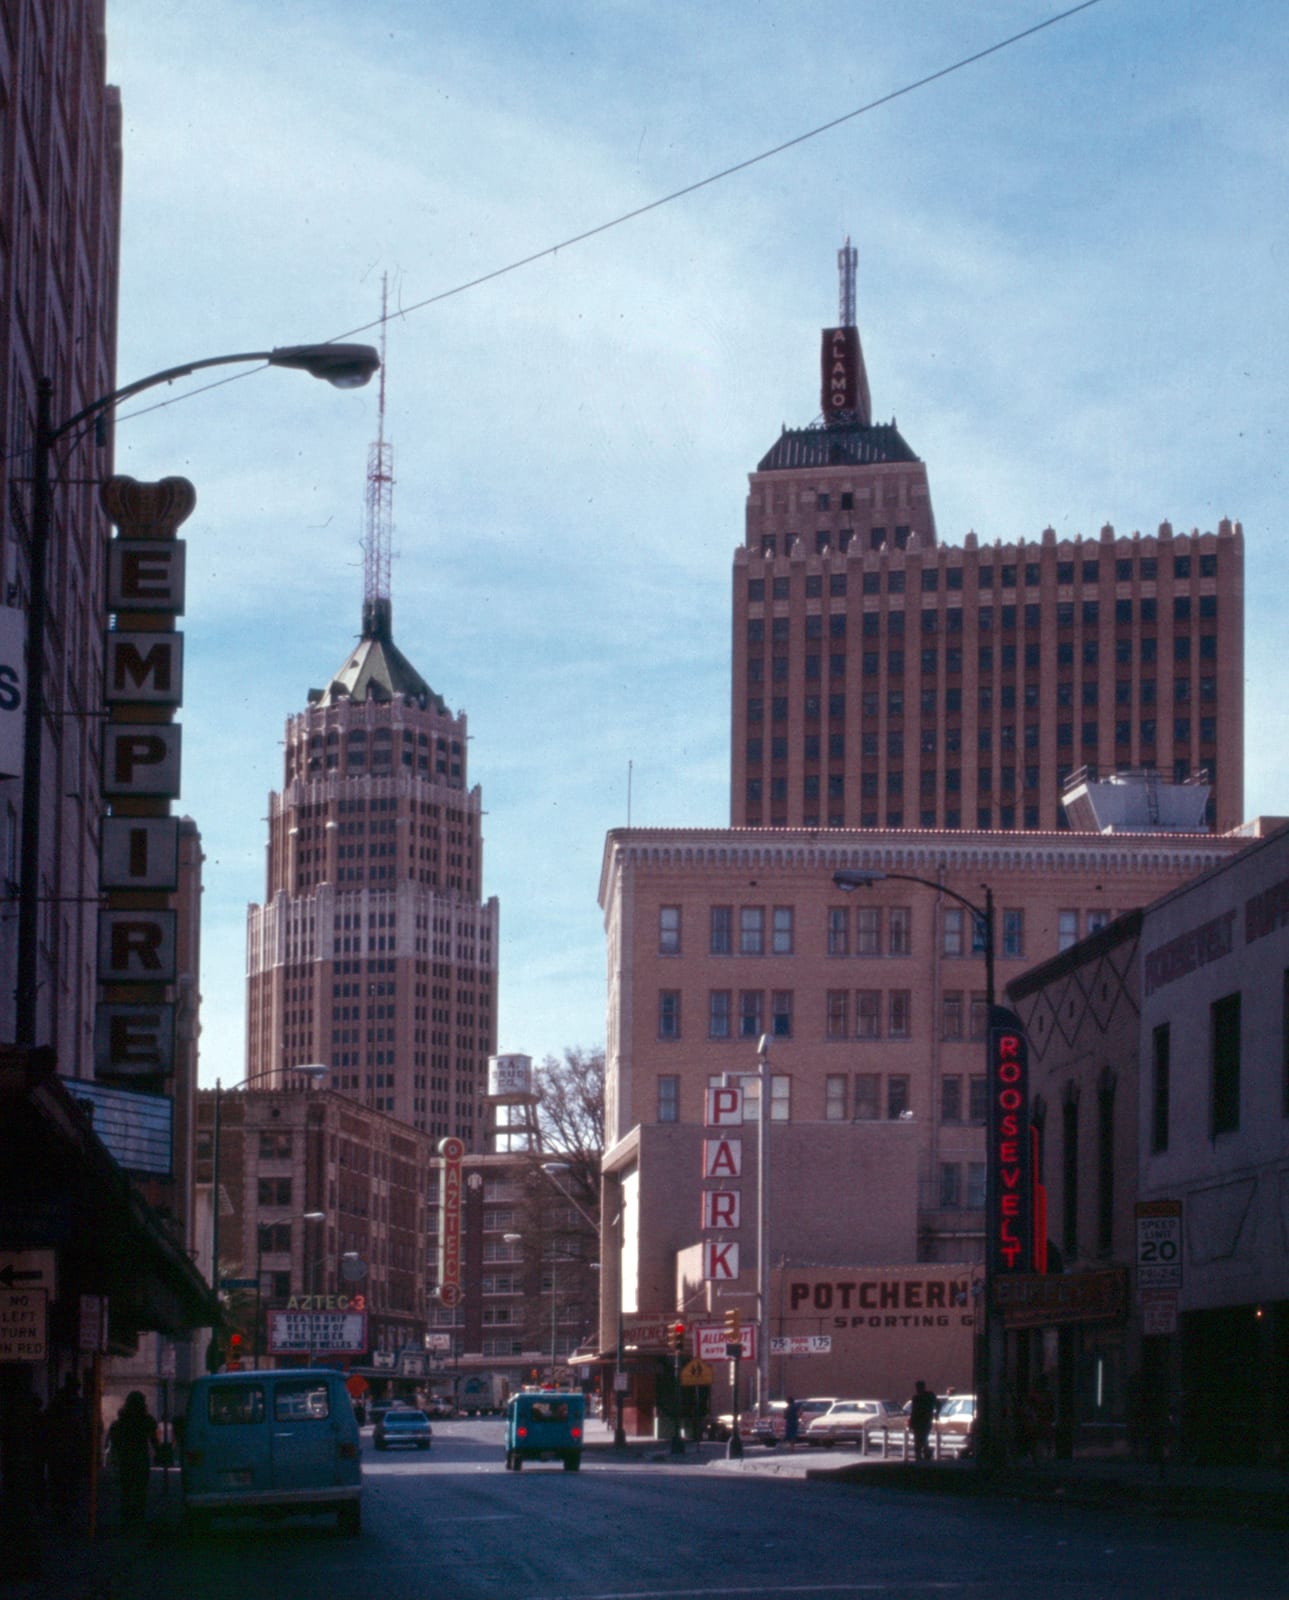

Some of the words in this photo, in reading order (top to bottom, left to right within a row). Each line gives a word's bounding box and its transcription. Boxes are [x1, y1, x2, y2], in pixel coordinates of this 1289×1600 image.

[831, 330, 847, 407] ALAMO
[110, 551, 173, 1065] EMPIRE
[999, 1036, 1022, 1268] ROOSEVELT
[710, 1089, 738, 1278] PARK
[446, 1167, 459, 1276] AZTEC
[1141, 1220, 1176, 1229] SPEED
[1144, 1230, 1171, 1239] LIMIT
[1141, 1241, 1177, 1261] 20
[446, 1286, 457, 1302] 3
[10, 1296, 29, 1306] NO
[2, 1312, 35, 1322] LEFT
[833, 1315, 949, 1328] SPORTING
[1, 1328, 36, 1338] TURN
[702, 1331, 749, 1344] ALLRT
[0, 1343, 12, 1353] N
[18, 1343, 42, 1353] RED
